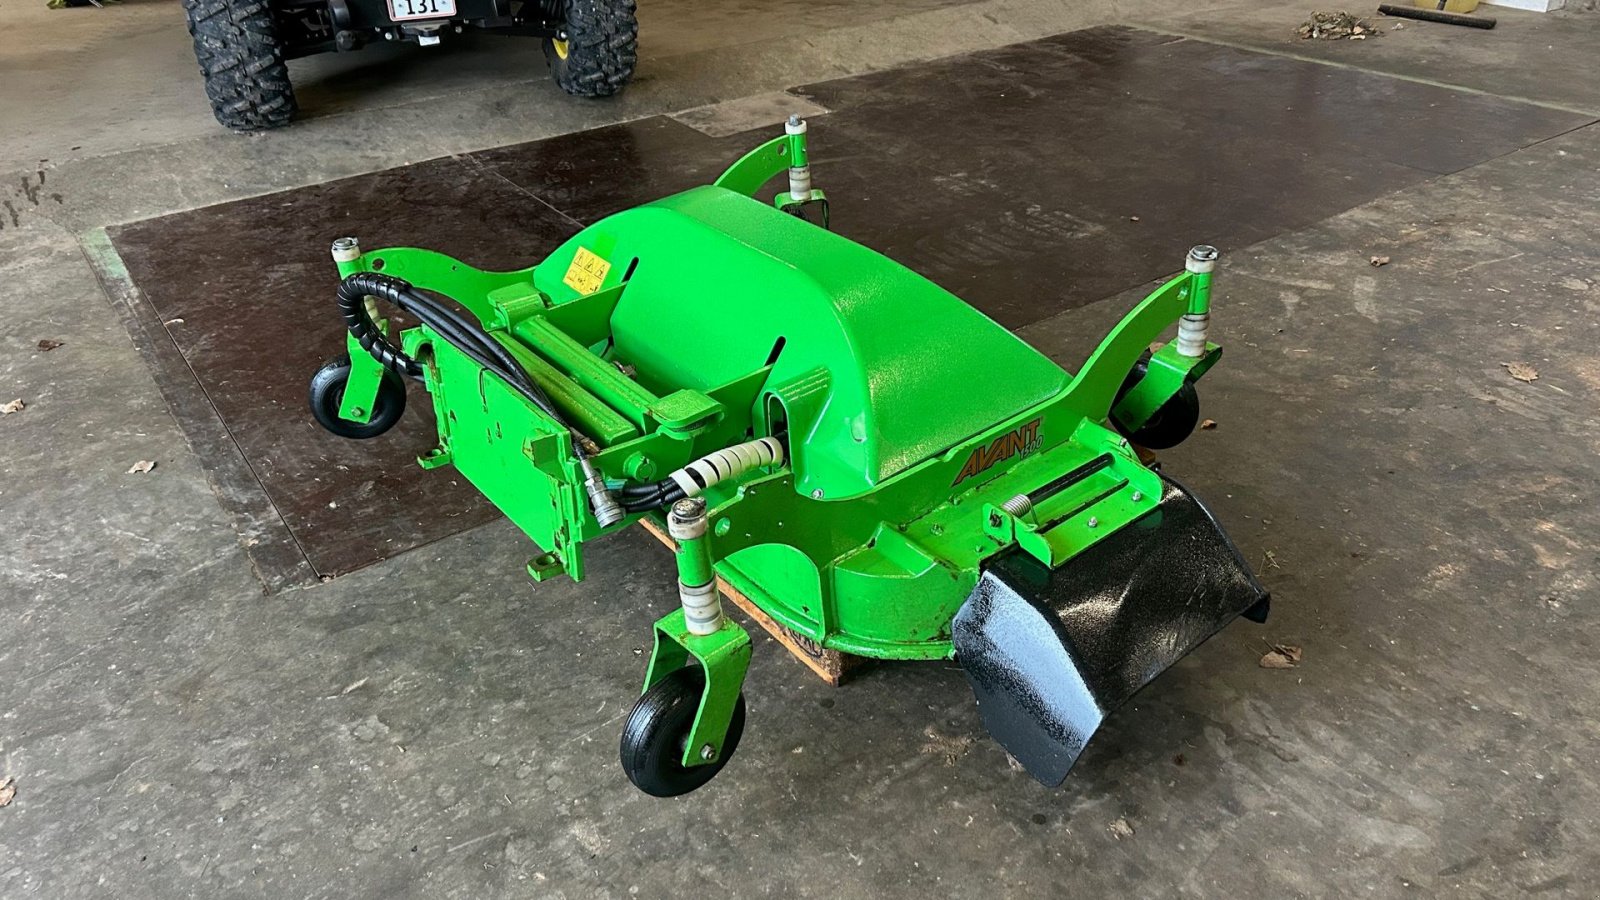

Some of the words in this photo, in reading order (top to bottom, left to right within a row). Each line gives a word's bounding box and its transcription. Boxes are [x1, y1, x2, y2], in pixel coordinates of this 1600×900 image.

[405, 0, 439, 15] 131
[950, 417, 1043, 488] AVANT
[1020, 435, 1044, 460] 1500
